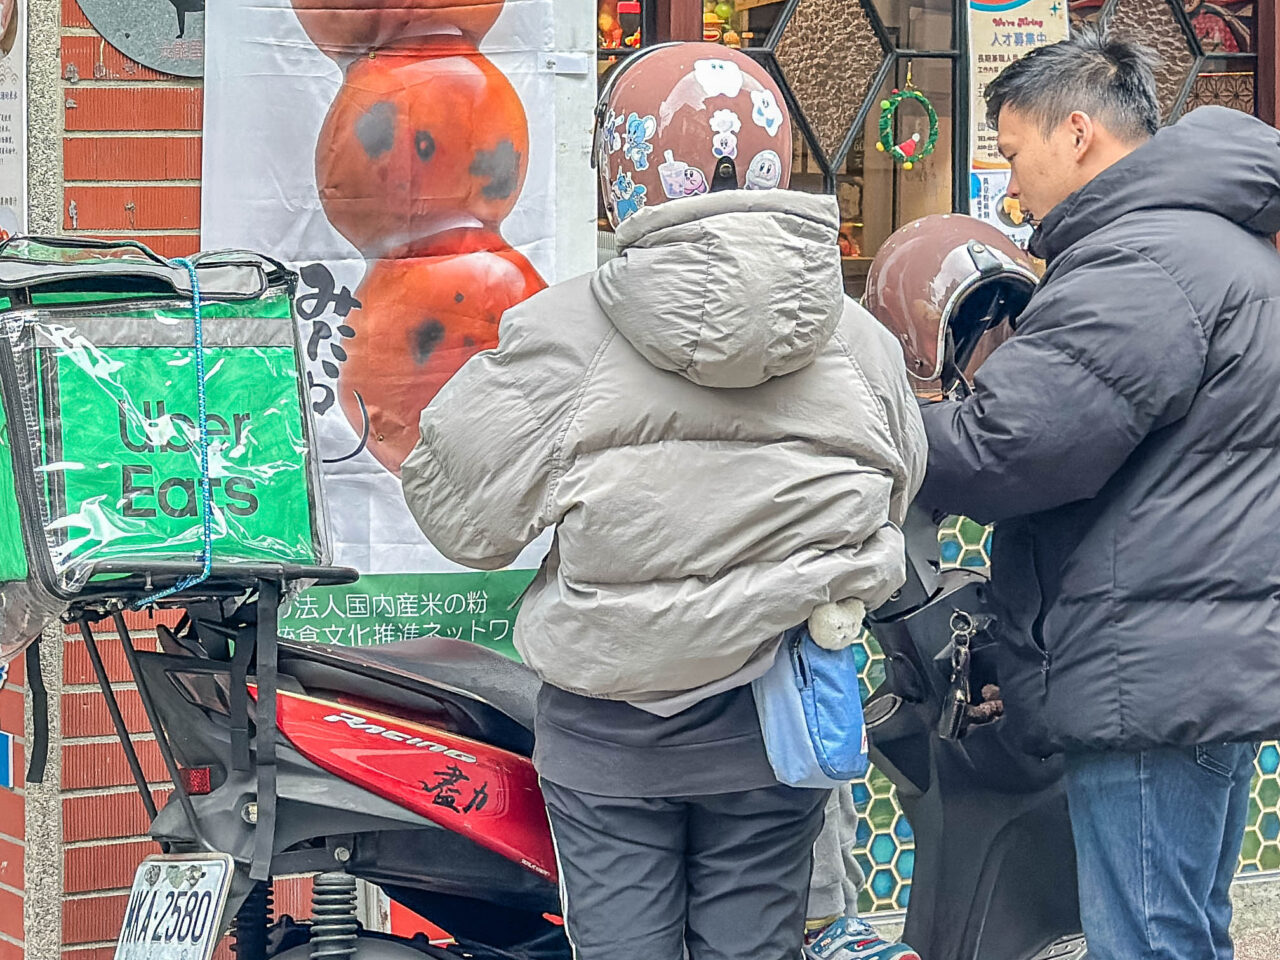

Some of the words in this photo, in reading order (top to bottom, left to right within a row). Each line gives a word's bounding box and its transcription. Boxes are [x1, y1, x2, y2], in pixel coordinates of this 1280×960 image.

[991, 31, 1047, 47] 人才募集中
[118, 400, 251, 453] Uber
[122, 464, 259, 518] Eats
[279, 619, 517, 646] 食文化推進ネットワ
[323, 712, 477, 763] RACING
